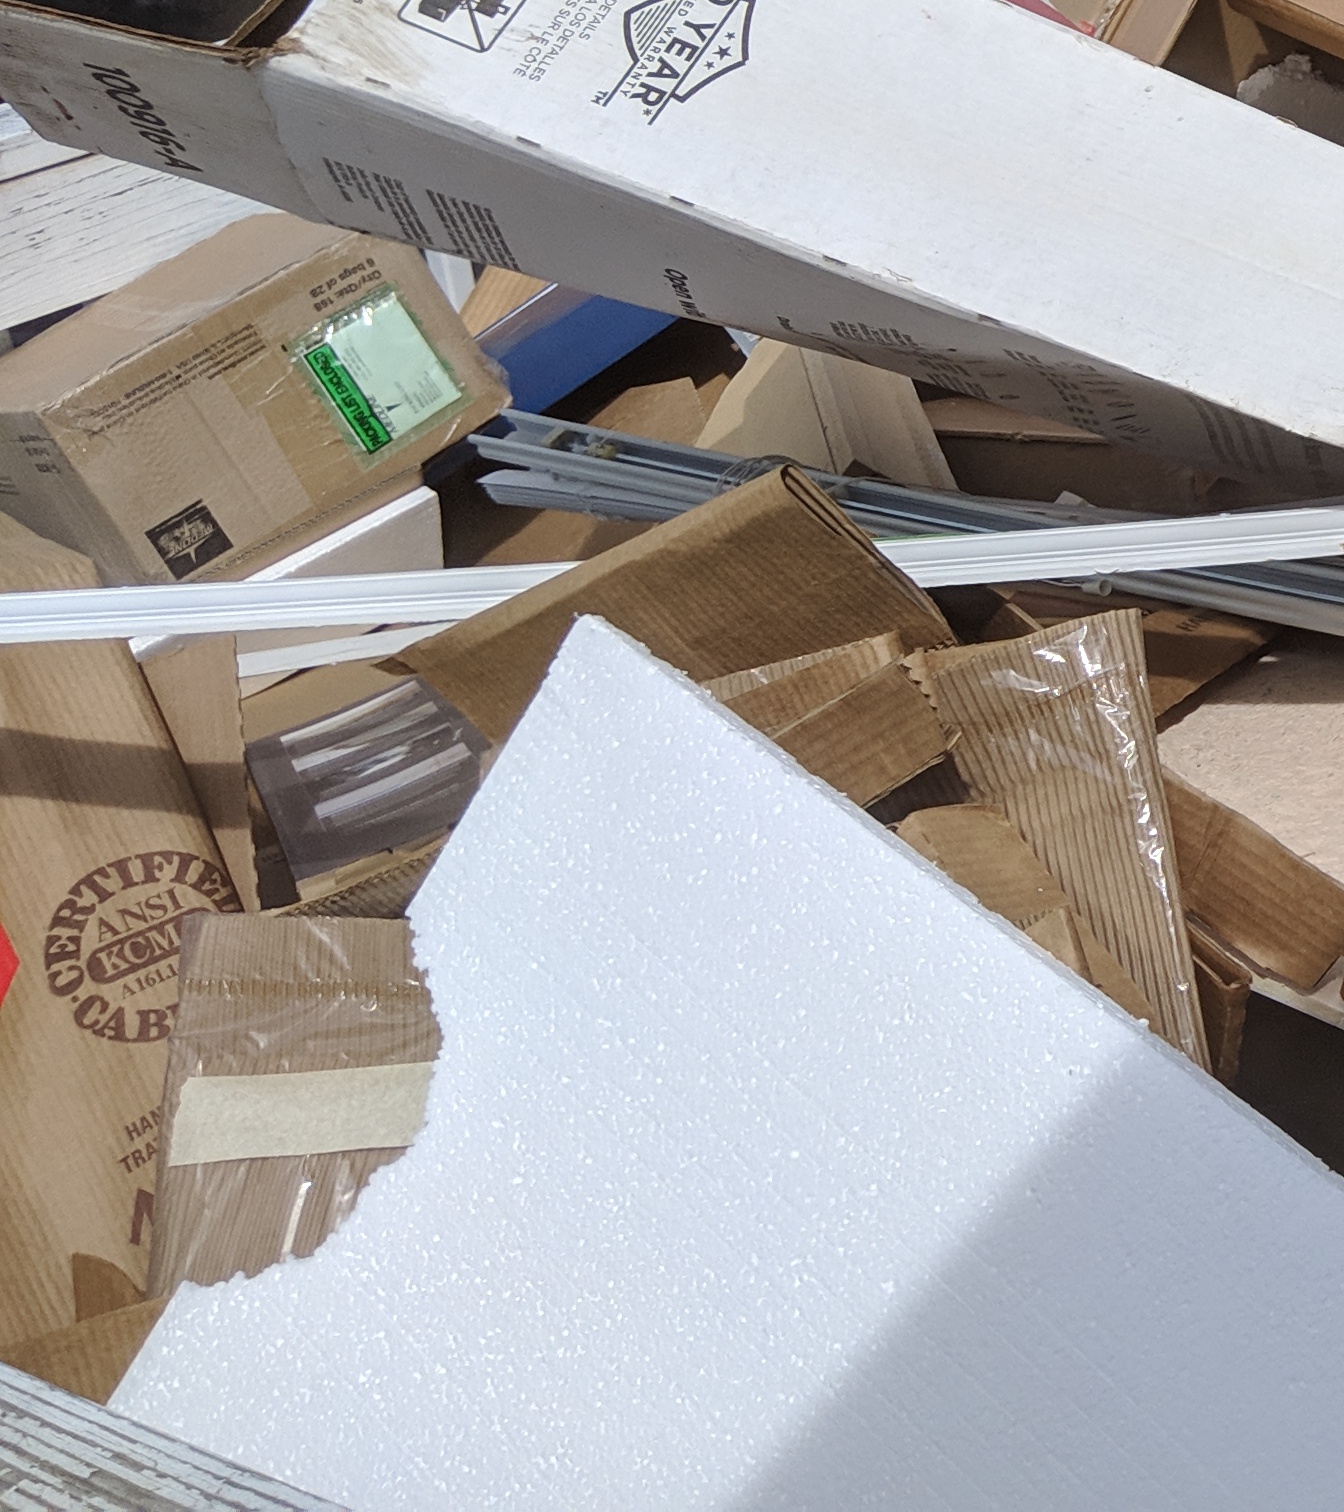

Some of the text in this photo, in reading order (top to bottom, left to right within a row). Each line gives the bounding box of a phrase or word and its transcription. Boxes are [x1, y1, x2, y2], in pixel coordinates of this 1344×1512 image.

[547, 8, 572, 31] SUR
[568, 5, 592, 29] LOS
[534, 30, 554, 47] LE
[512, 46, 542, 78] CÔTÉ
[528, 27, 576, 82] DETALLES
[618, 25, 678, 98] WARRANTY
[588, 87, 609, 107] TM
[82, 62, 204, 173] 100916-A
[325, 277, 338, 291] of
[337, 262, 367, 282] bags
[339, 391, 362, 414] LIST
[351, 408, 384, 448] PACKING
[97, 886, 185, 943] ANSI
[121, 963, 179, 1000] A161.1
